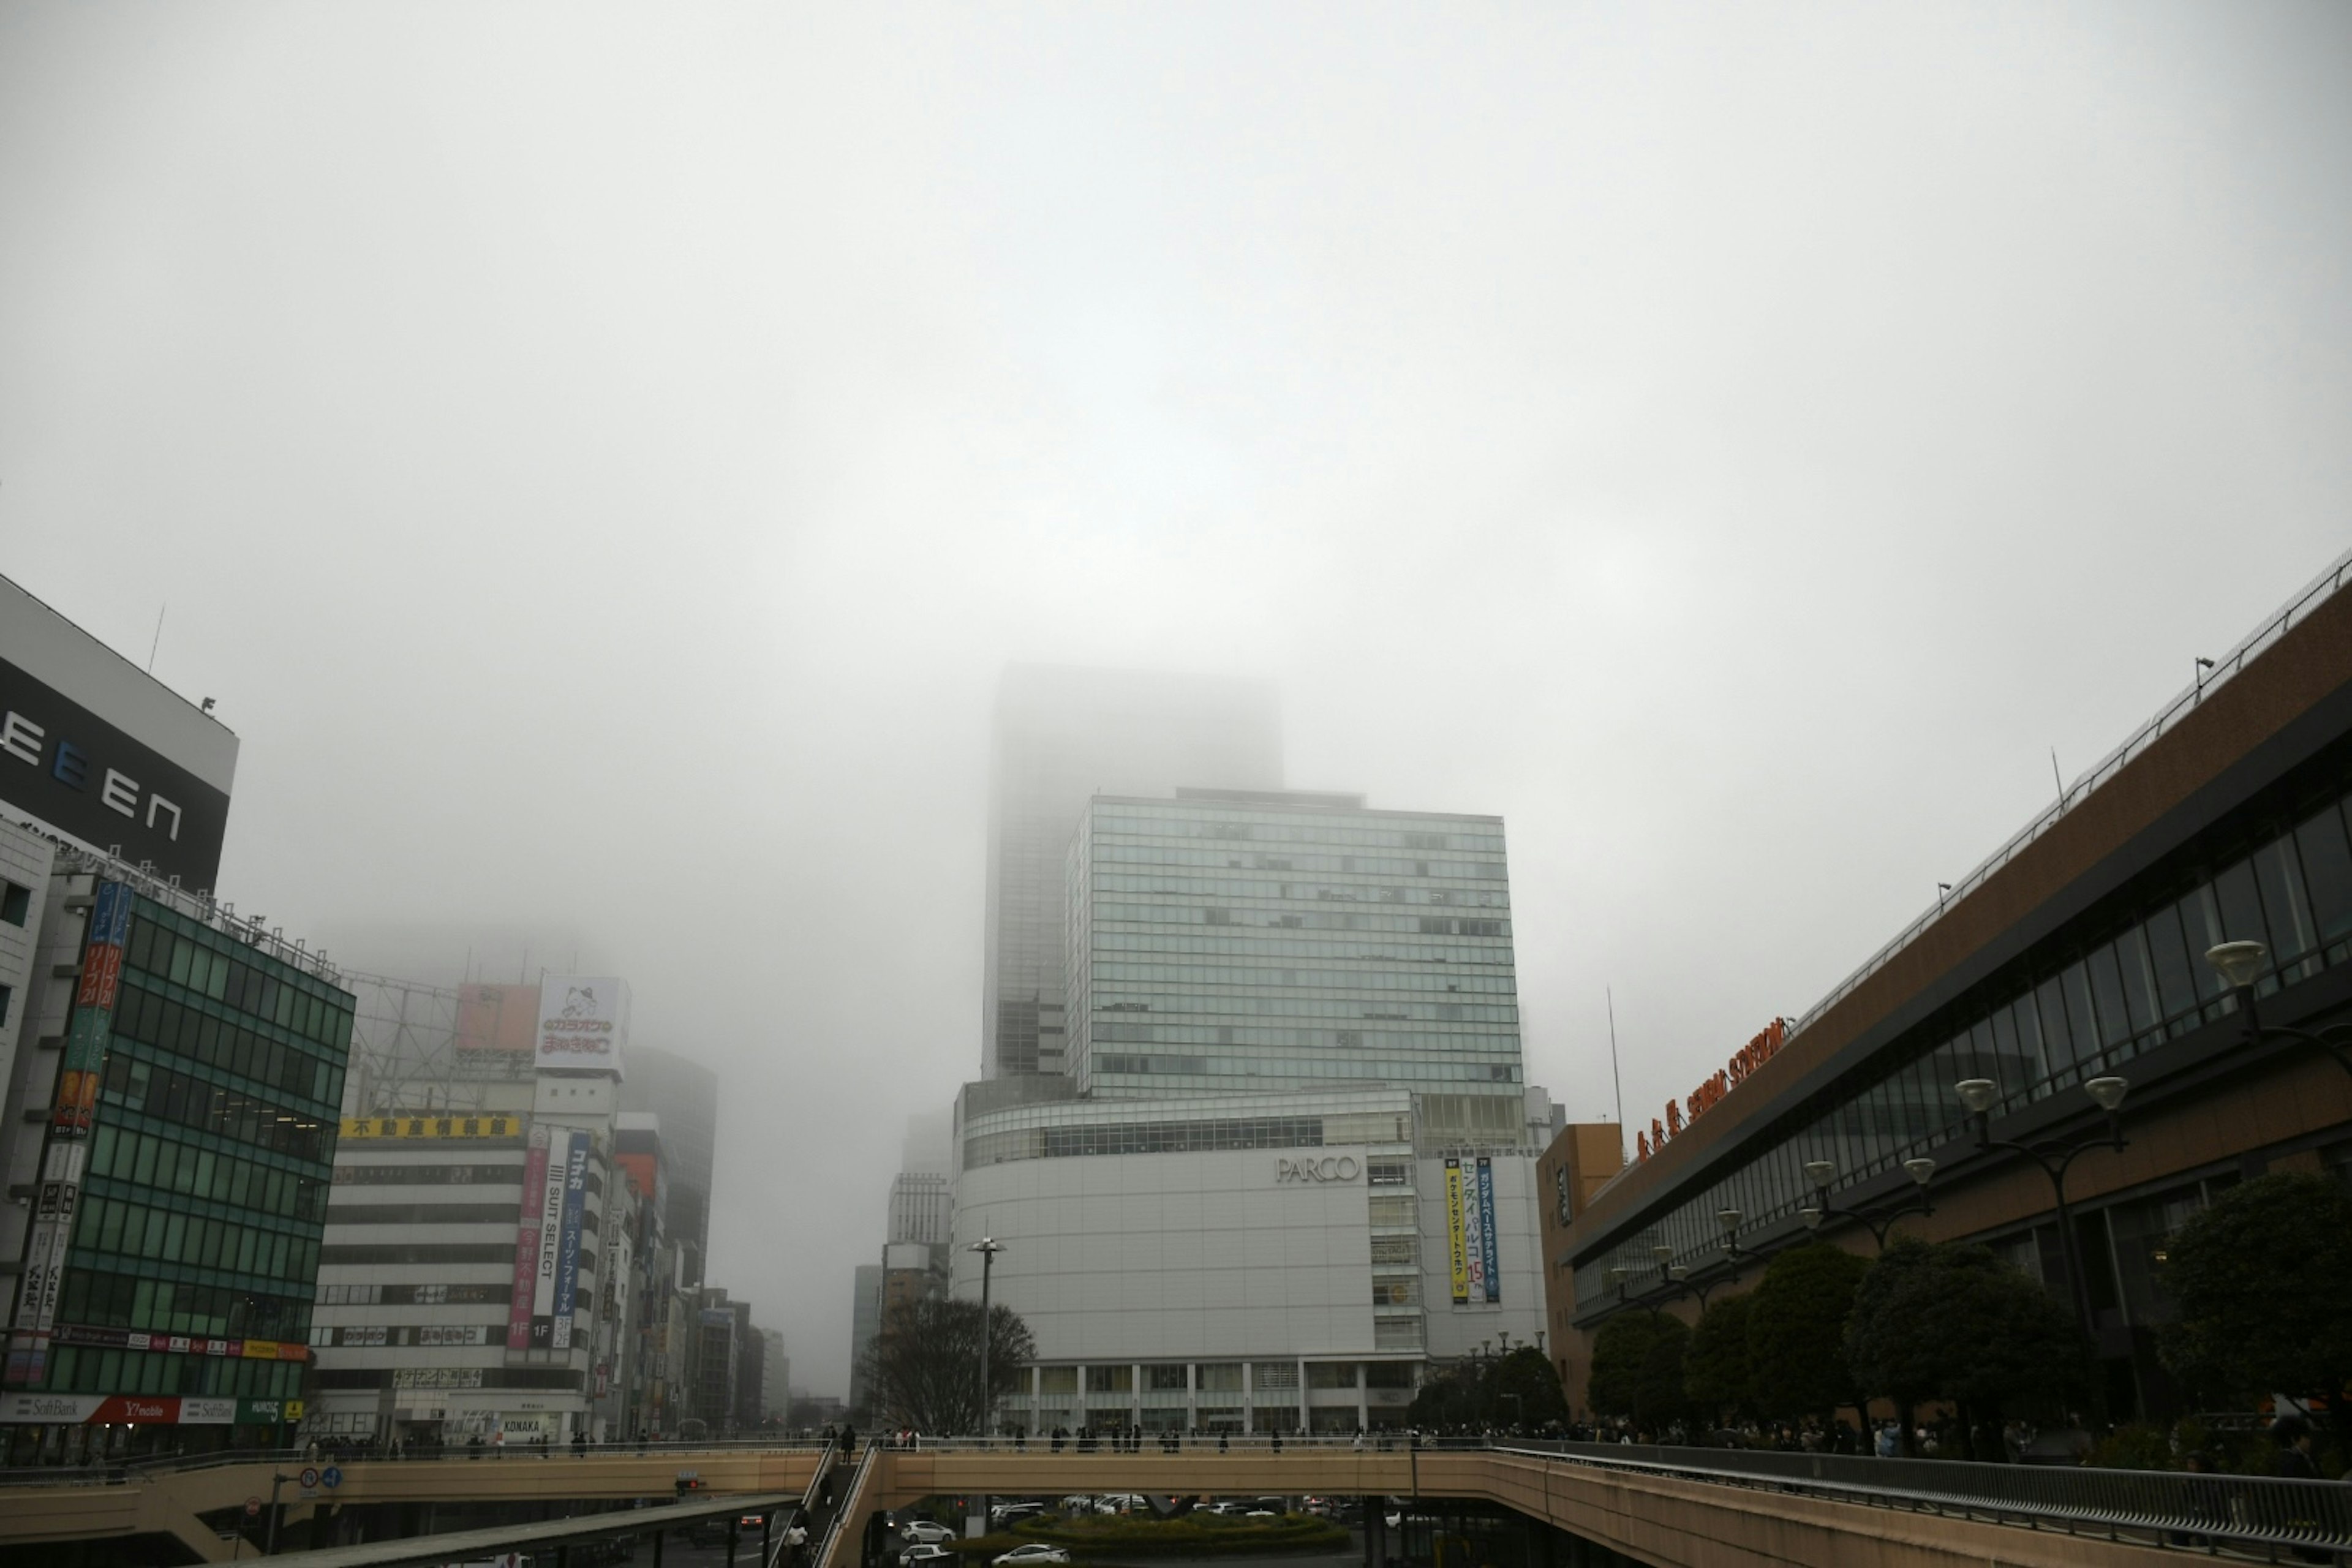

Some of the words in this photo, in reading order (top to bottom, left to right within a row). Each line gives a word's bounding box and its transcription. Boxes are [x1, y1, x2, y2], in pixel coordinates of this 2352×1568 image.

[81, 945, 104, 1004] リーブ21
[101, 948, 120, 1005] リーブ21
[554, 1019, 601, 1031] カラオケ
[543, 1035, 610, 1054] まねきねこ
[339, 1119, 507, 1136] 不動産情報館
[568, 1150, 587, 1190] コナカ
[1276, 1157, 1360, 1183] PARCO
[548, 1187, 560, 1220] SUIT
[1450, 1175, 1463, 1275] ポケモンセンタートウホク
[1466, 1217, 1479, 1258] パルコ
[541, 1223, 556, 1280] SELECT
[560, 1230, 576, 1312] スーツ・フォーマル
[1468, 1262, 1483, 1283] 15
[510, 1321, 530, 1336] 1F
[533, 1324, 549, 1337] 1F
[557, 1317, 571, 1331] 3F
[556, 1334, 569, 1345] 2F
[33, 1399, 78, 1416] SoftBank
[202, 1403, 232, 1417] SoftBank
[504, 1420, 540, 1432] KONAKA
